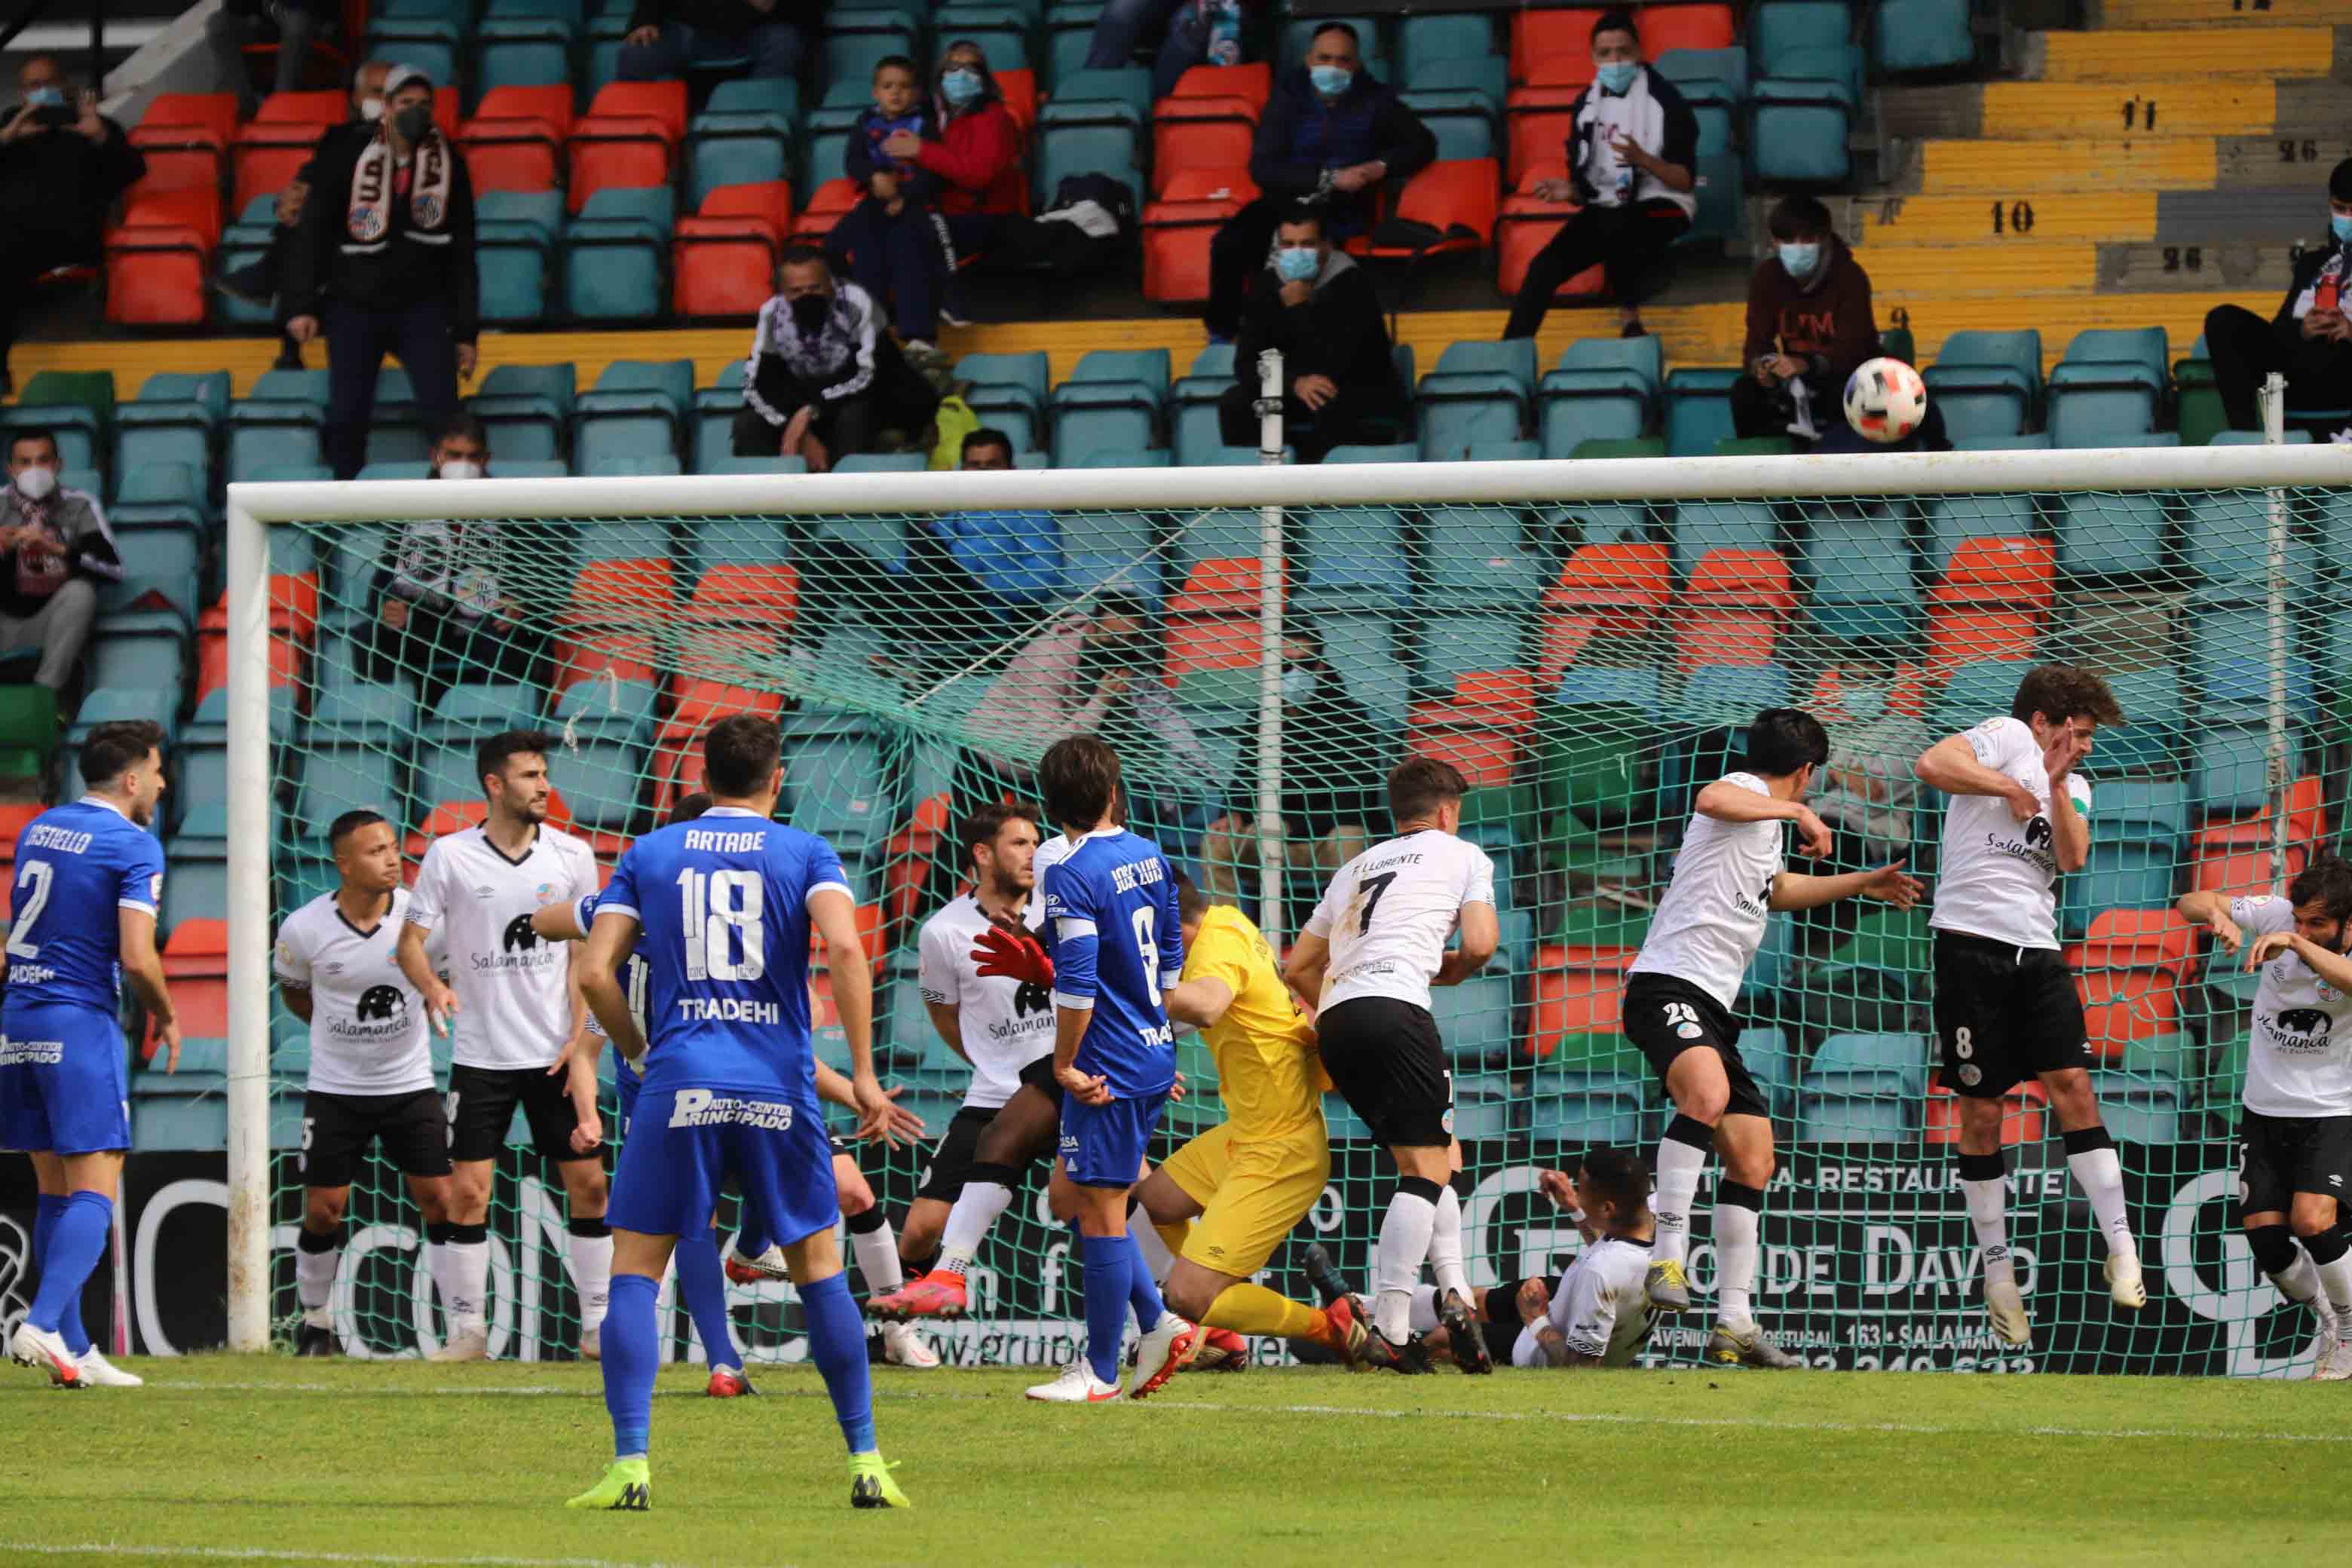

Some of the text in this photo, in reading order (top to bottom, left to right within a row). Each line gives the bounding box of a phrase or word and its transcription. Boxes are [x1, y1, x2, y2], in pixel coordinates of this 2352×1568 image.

[1992, 200, 2035, 233] 10
[684, 829, 767, 853] ARTABE
[1362, 853, 1424, 872] LLORENTE
[6, 859, 53, 960] 2
[1357, 871, 1397, 939] 7
[676, 868, 764, 982] 18
[678, 998, 779, 1025] TRADEHI
[988, 1015, 1055, 1039] Salaman
[1955, 1026, 1973, 1059] 8
[668, 1089, 792, 1131] PRINCIPADO
[709, 1098, 793, 1117] AUTO-CENTER
[1819, 1166, 2064, 1195] RESTAURNTE
[1766, 1245, 1836, 1294] DE
[1864, 1225, 2038, 1296] DAVD
[1649, 1331, 1710, 1347] AVENI
[1846, 1325, 1881, 1348] 163
